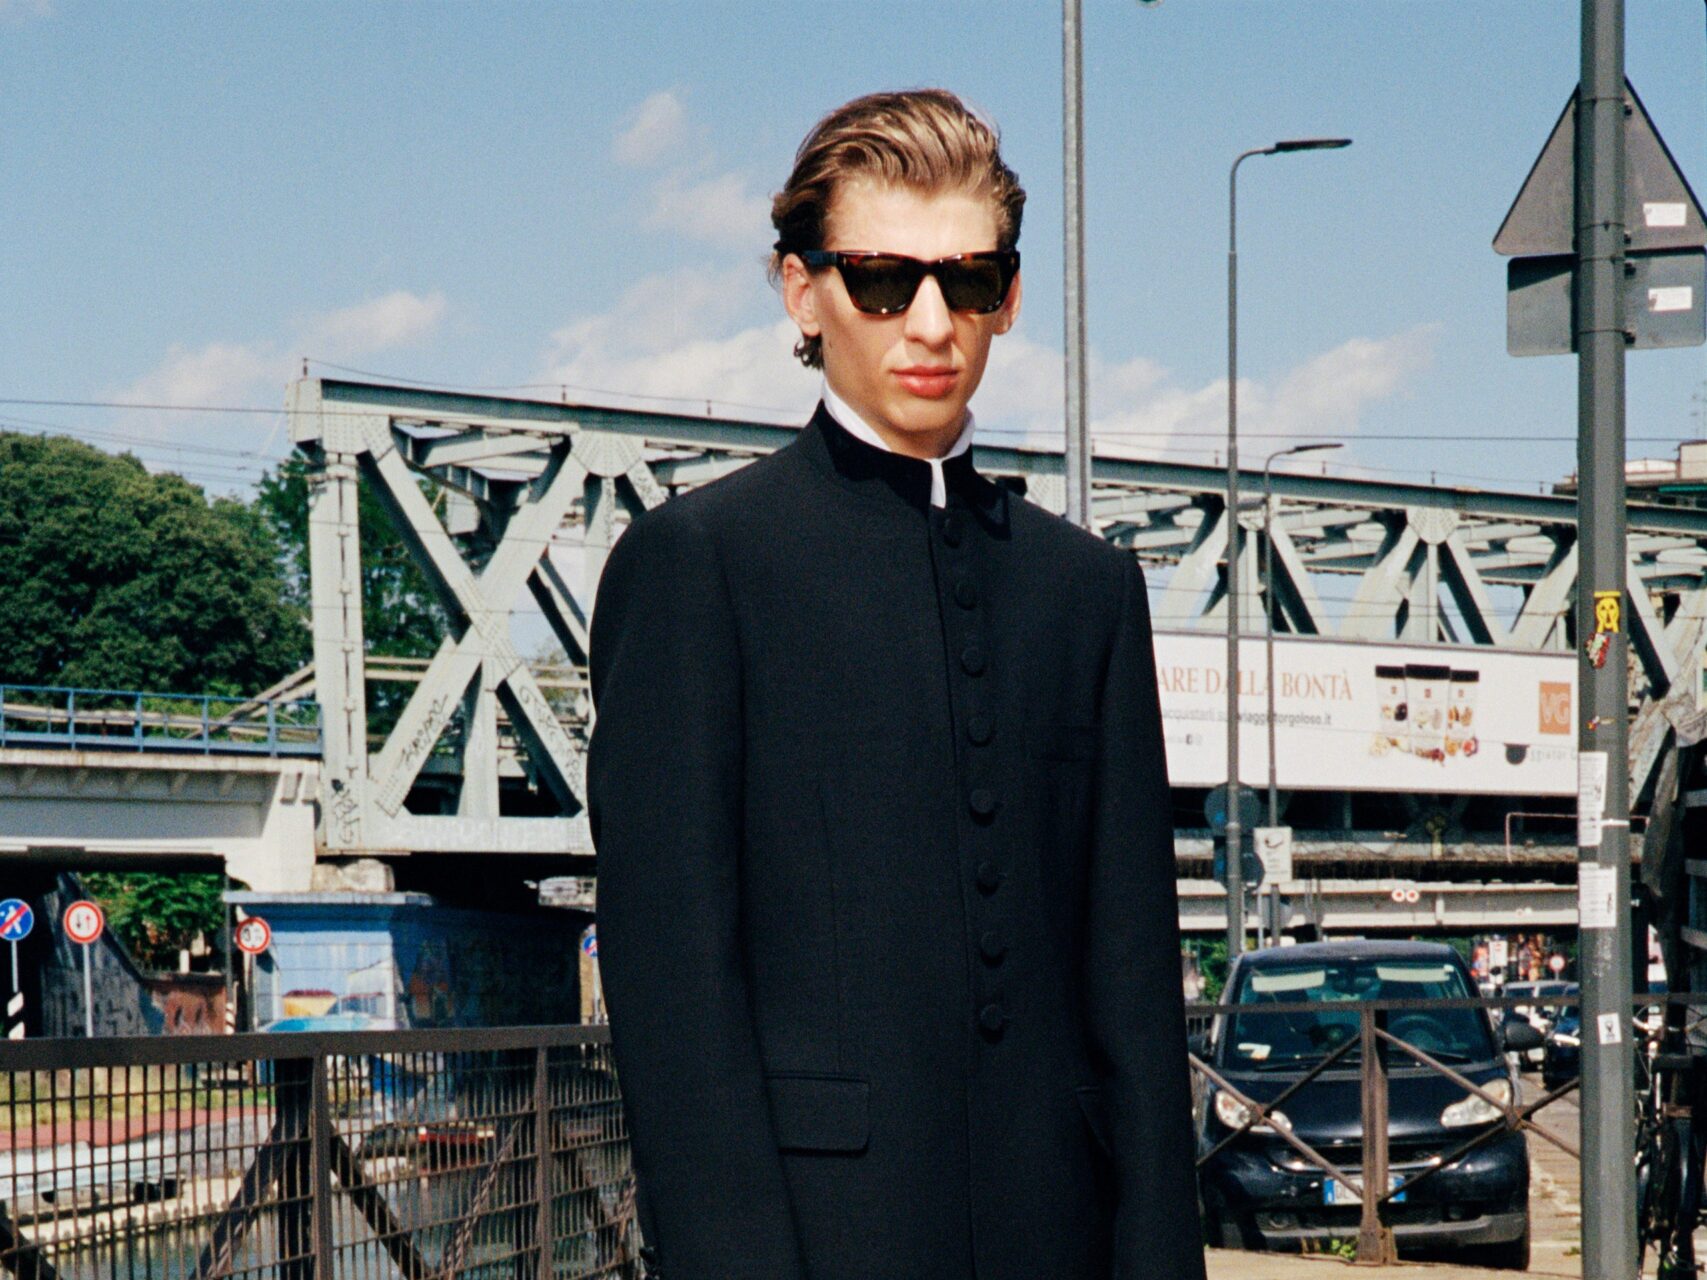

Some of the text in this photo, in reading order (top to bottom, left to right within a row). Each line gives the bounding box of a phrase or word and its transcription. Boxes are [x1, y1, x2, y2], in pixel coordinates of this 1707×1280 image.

[1205, 667, 1273, 697] DLL
[1281, 668, 1353, 701] BONTÀ
[1542, 692, 1569, 724] VG
